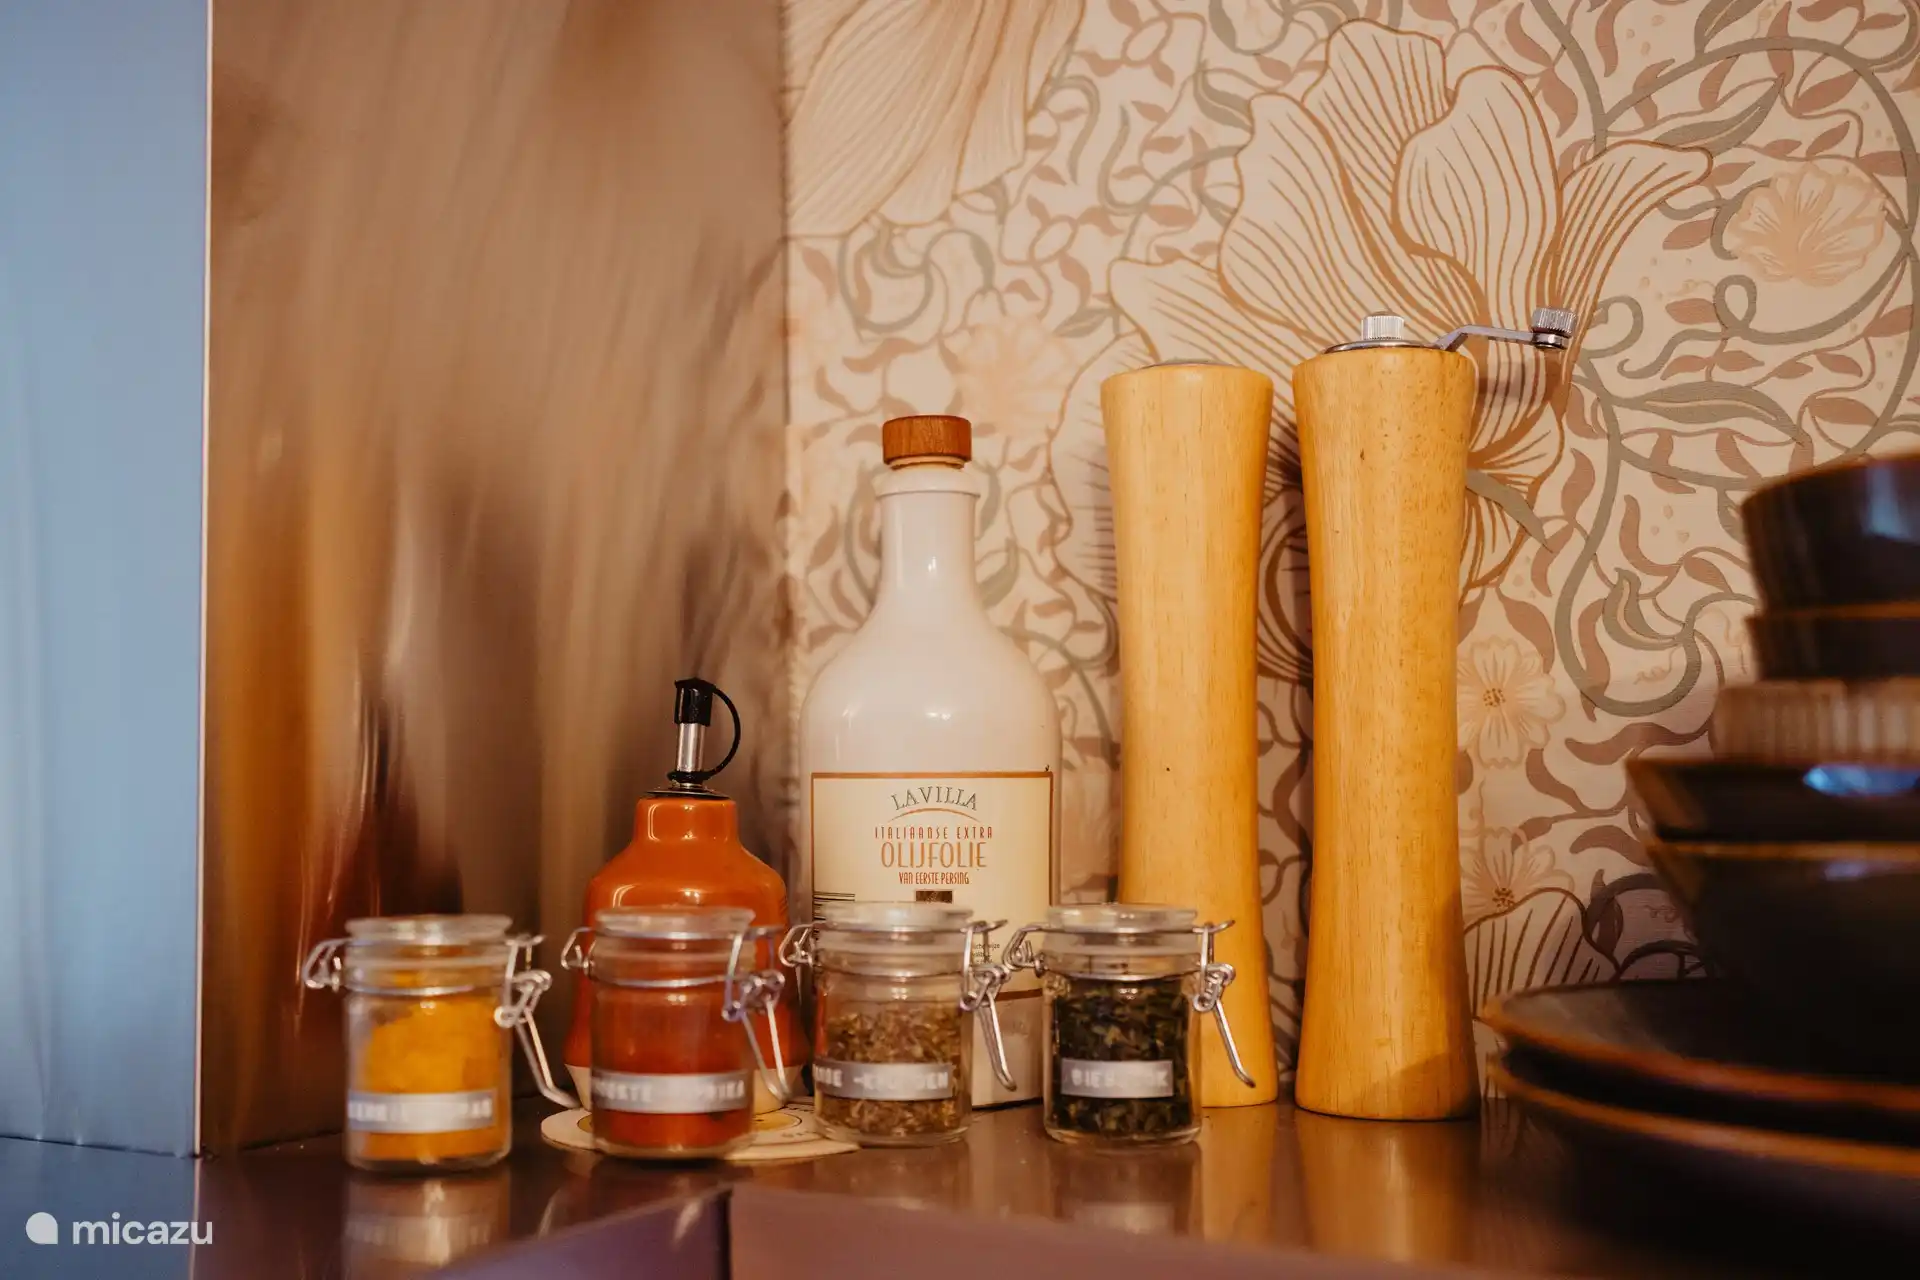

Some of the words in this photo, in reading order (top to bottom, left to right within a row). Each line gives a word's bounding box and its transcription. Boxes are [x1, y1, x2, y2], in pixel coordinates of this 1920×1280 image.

[875, 826, 948, 839] ITALIAANSE
[956, 826, 992, 839] EXTRA
[881, 841, 987, 868] OLIJFOLIE
[899, 871, 913, 885] VAN
[915, 871, 939, 885] EERSTE
[940, 871, 970, 885] PERSING
